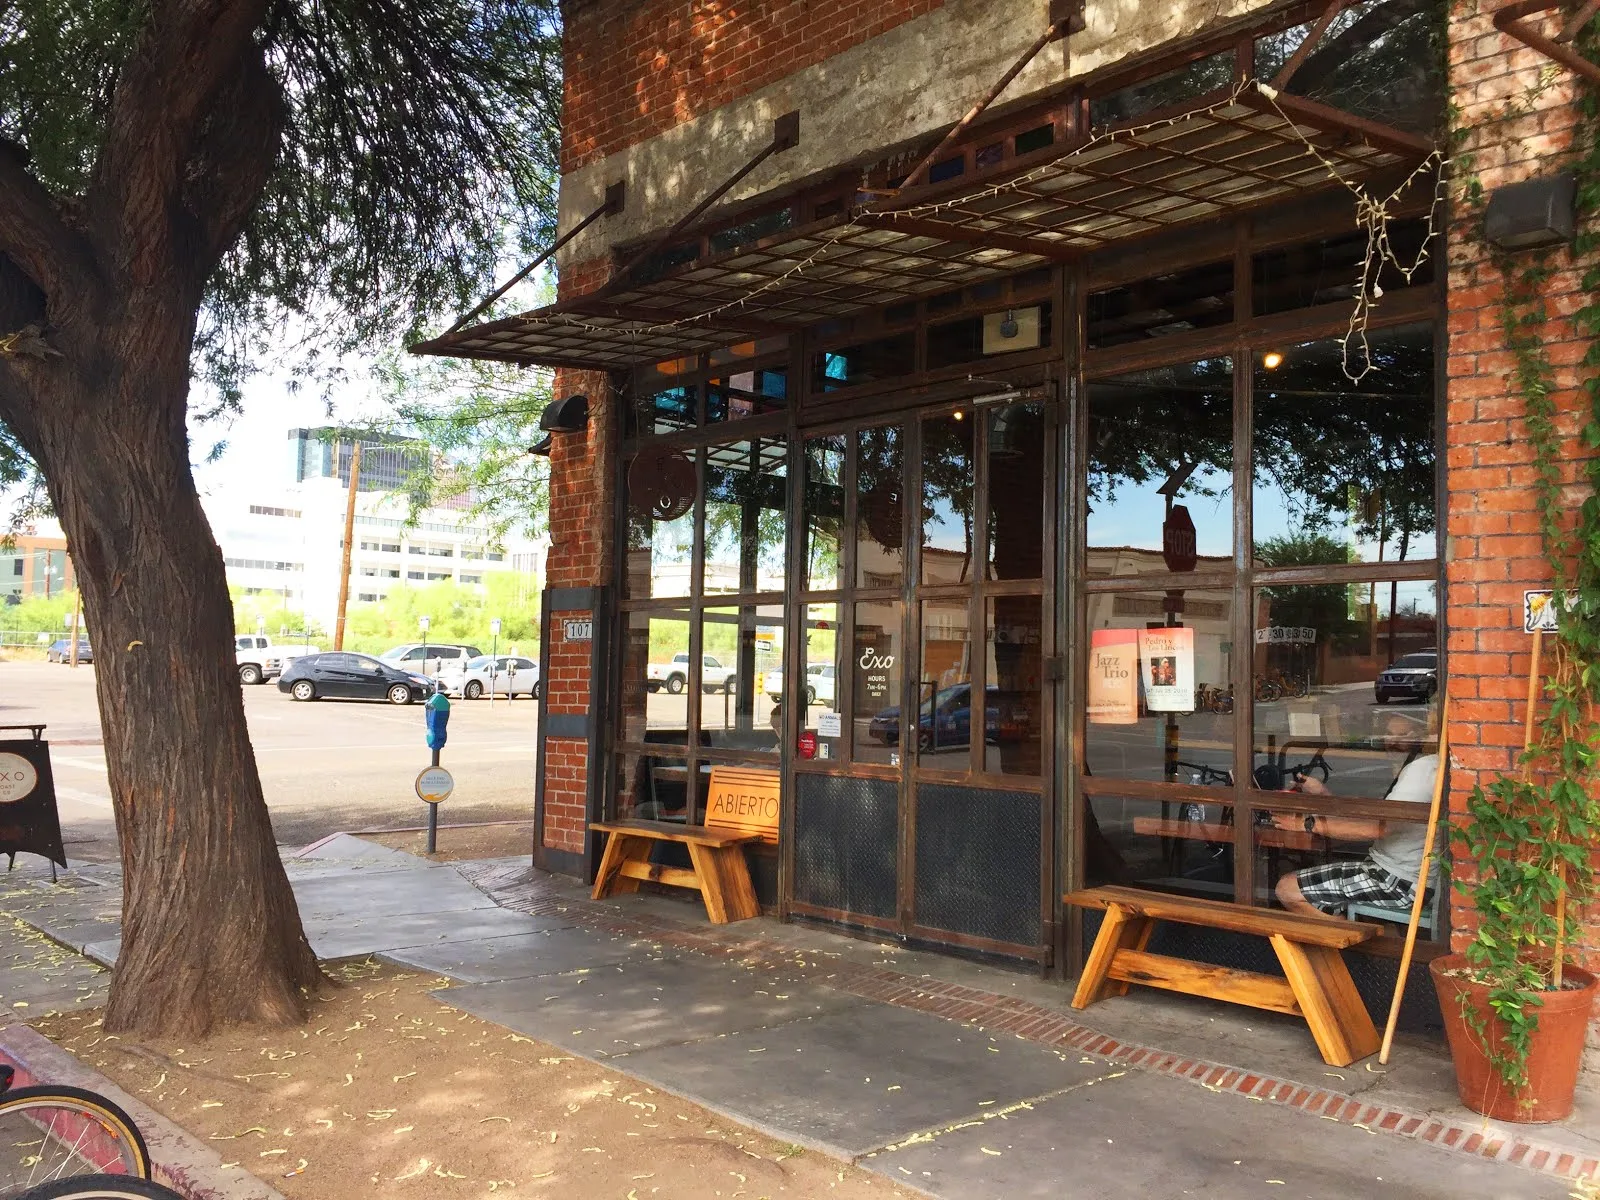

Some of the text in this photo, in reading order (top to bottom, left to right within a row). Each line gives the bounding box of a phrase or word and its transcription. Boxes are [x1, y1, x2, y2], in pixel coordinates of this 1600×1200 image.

[571, 624, 589, 637] 107
[860, 647, 895, 670] Exo
[1095, 653, 1120, 668] Jazz
[1103, 665, 1129, 678] Trio
[713, 793, 779, 818] ABIERTO
